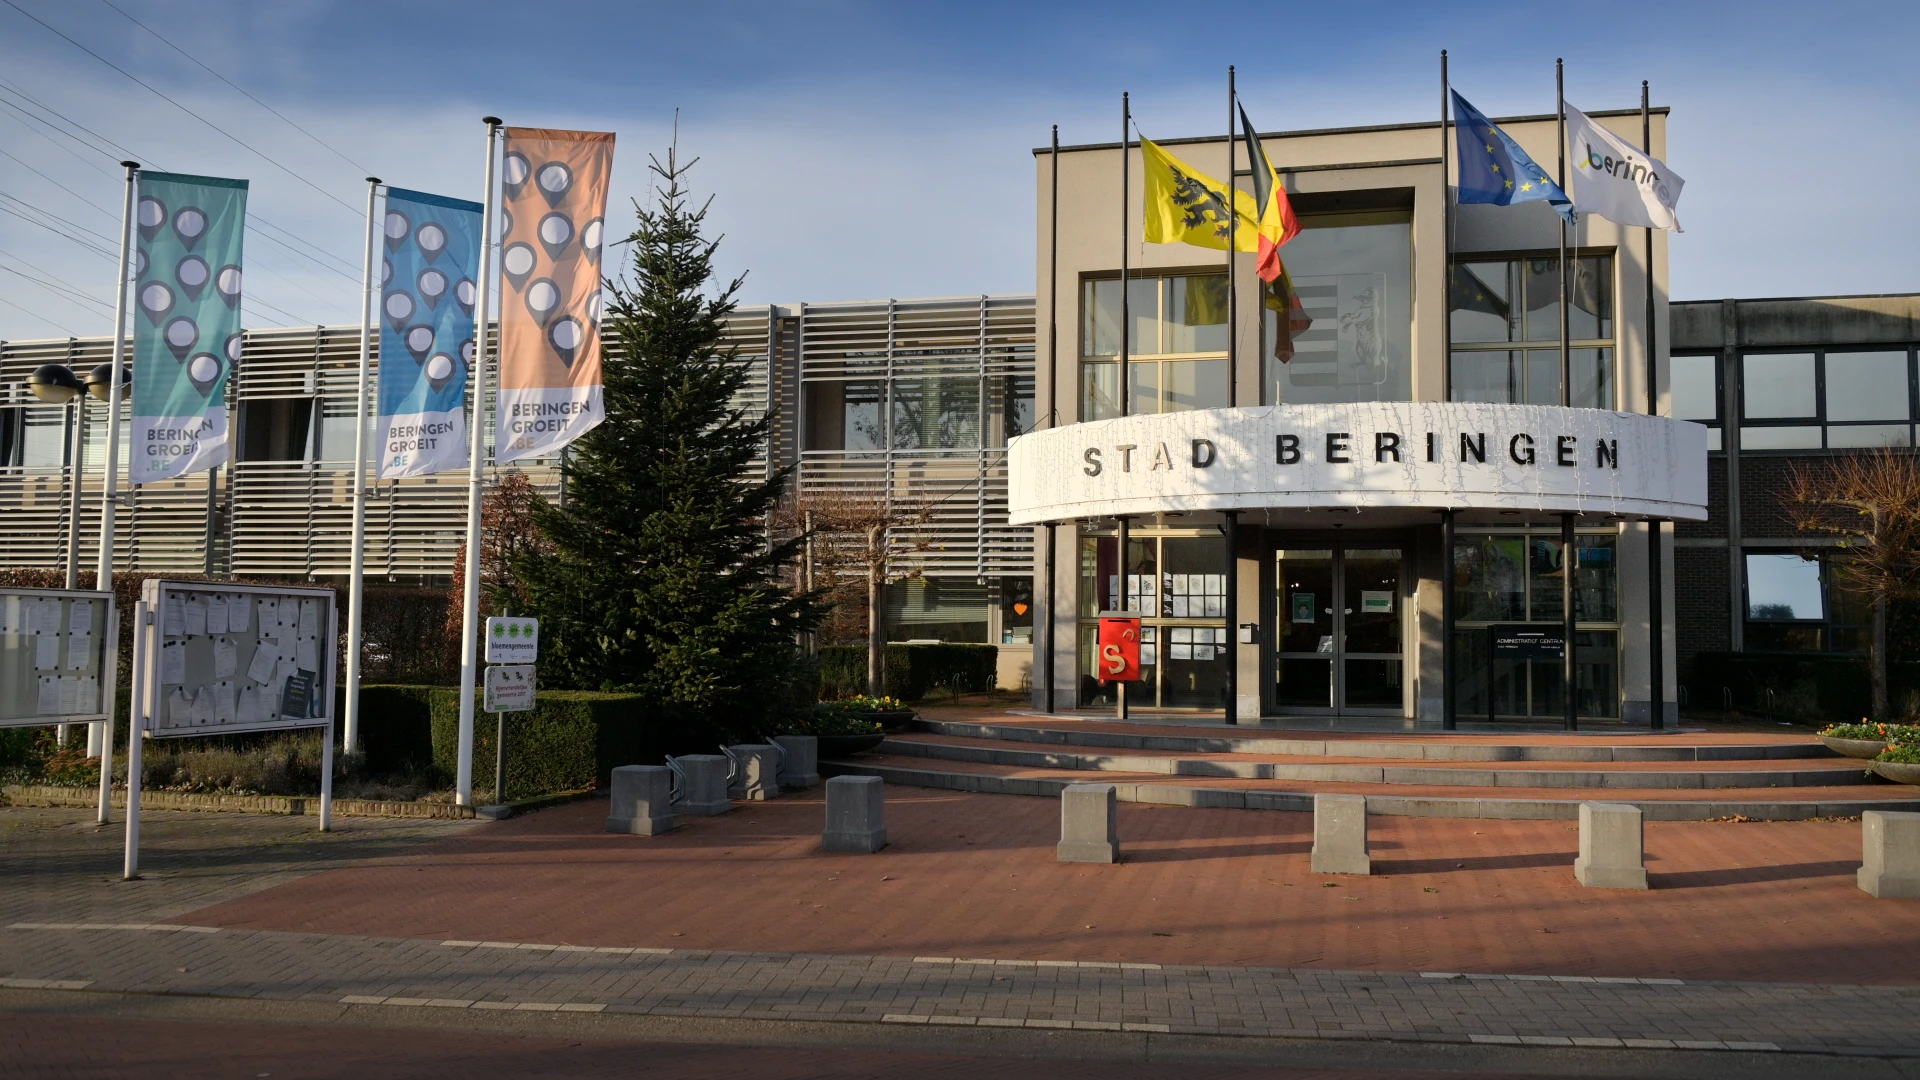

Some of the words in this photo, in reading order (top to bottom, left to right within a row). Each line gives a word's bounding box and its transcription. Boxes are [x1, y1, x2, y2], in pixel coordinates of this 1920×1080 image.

[512, 400, 591, 417] BERINGEN
[390, 421, 454, 438] BERINGEN
[511, 418, 570, 434] GROEIT
[389, 438, 437, 453] GROEIT
[510, 437, 536, 450] .BE
[389, 455, 408, 468] .BE
[1083, 438, 1217, 477] STAD
[1276, 432, 1618, 469] BERINGEN
[146, 460, 170, 472] .BE
[491, 641, 534, 651] bloemengemeente
